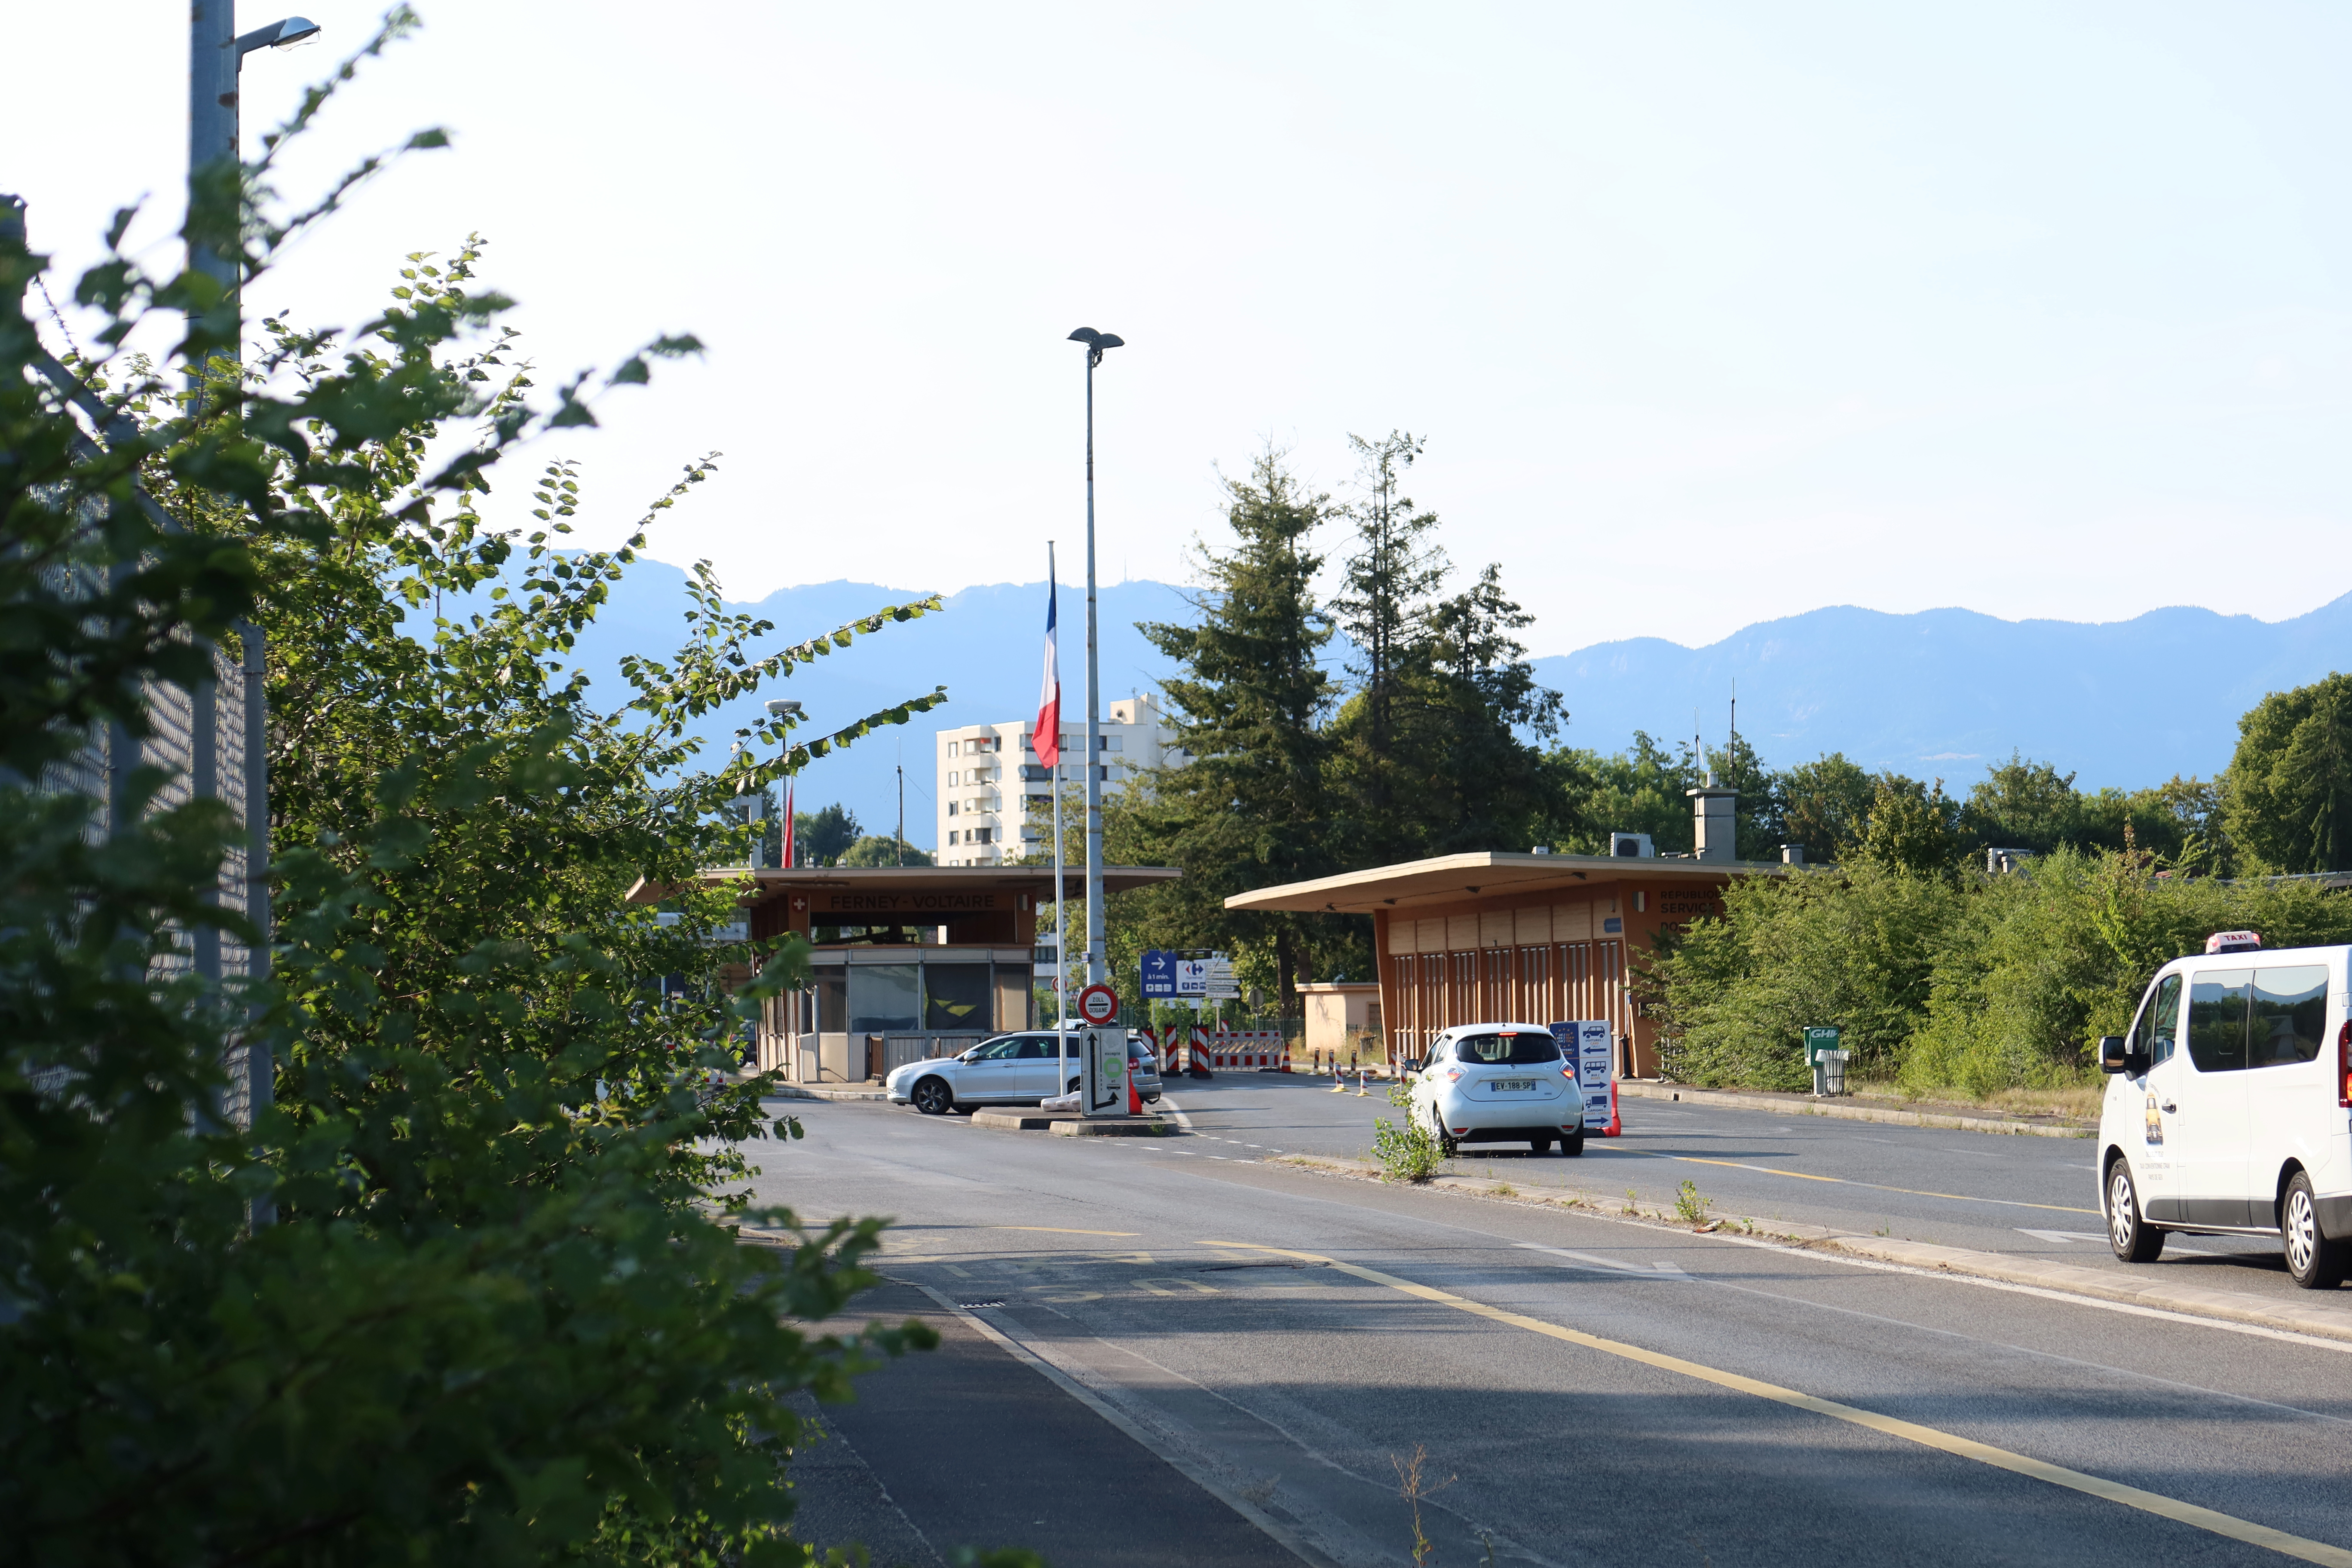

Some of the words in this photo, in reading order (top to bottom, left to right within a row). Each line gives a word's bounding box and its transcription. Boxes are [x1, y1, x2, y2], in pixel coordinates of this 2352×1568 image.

[1661, 890, 1720, 899] RÉPUBLIQU
[830, 895, 900, 909] FERNEY
[913, 894, 994, 908] VOLTAIRE
[1661, 903, 1715, 913] SERVICE
[1811, 1029, 1838, 1038] GHI
[1496, 1082, 1531, 1090] EV-188-SP
